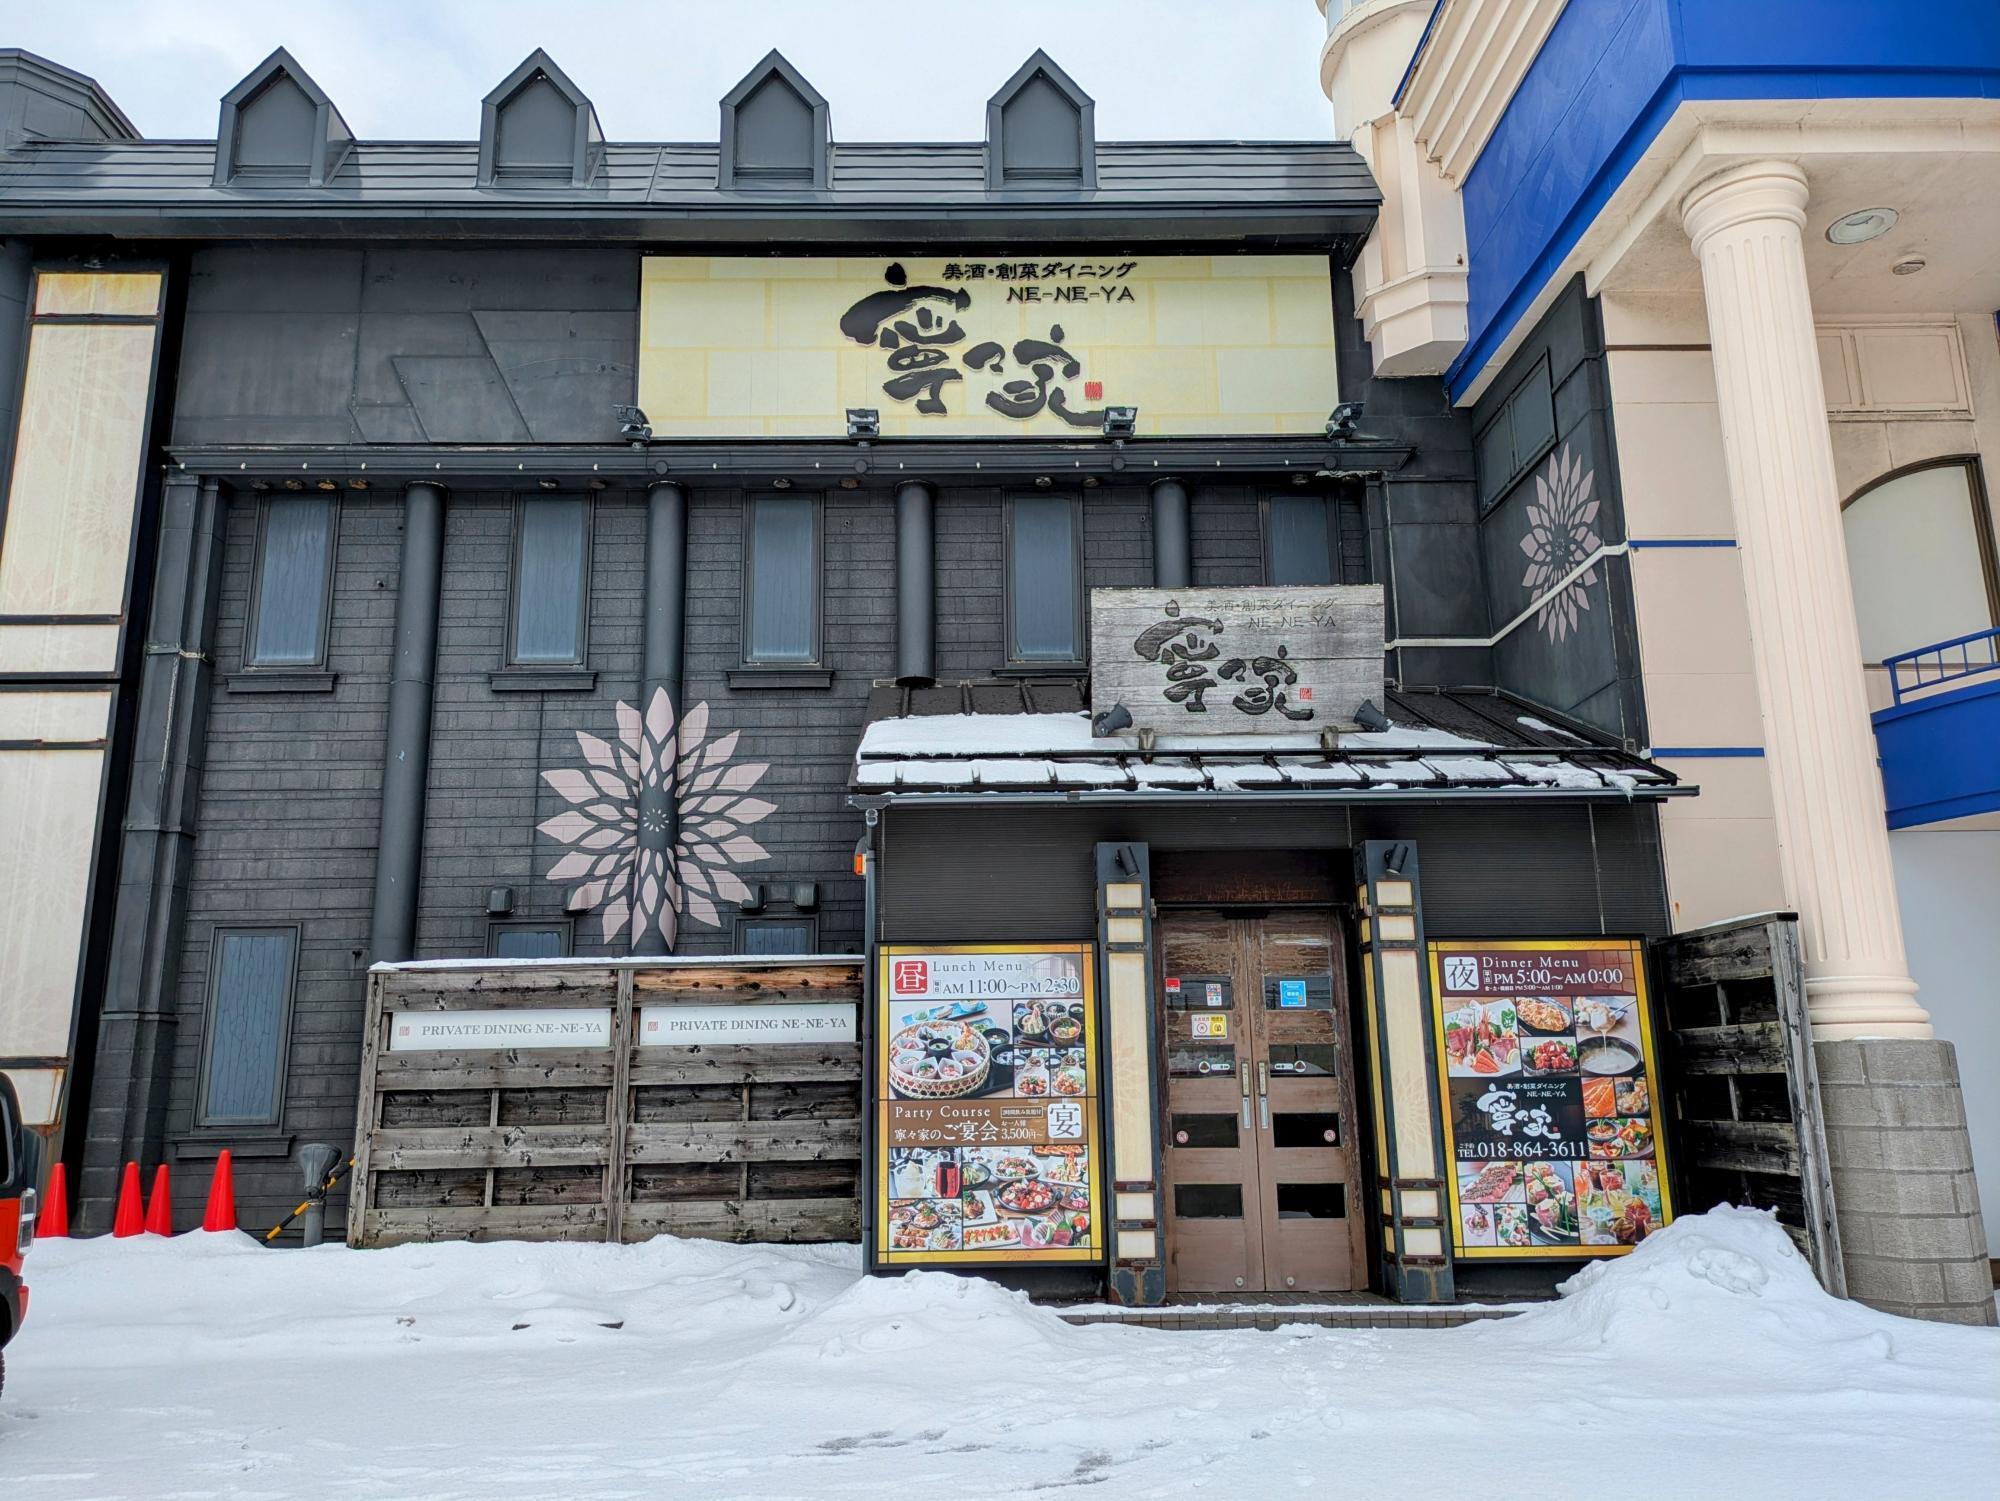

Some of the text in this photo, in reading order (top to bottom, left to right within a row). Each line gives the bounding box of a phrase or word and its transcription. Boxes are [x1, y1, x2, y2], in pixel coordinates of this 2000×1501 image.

[943, 262, 1138, 280] 美酒・創菜ダイニング
[1006, 286, 1136, 303] NE-NE-YA
[933, 960, 1023, 972] Lunch Menu
[1482, 956, 1579, 968] Dinner Menu
[896, 963, 926, 993] 昼
[1446, 958, 1478, 988] 夜
[1494, 974, 1514, 985] PM
[1587, 968, 1623, 984] 0:00
[942, 982, 964, 994] AM
[1044, 977, 1079, 994] 2:30
[422, 1024, 481, 1036] PRIVATE
[484, 1023, 532, 1035] DINING
[535, 1022, 602, 1034] NE-NE-YA
[670, 1020, 728, 1031] PRIVATE
[731, 1019, 778, 1030] DINING
[781, 1017, 847, 1029] NE-NE-YA
[894, 1105, 991, 1121] Party Course
[1049, 1104, 1080, 1137] 宴
